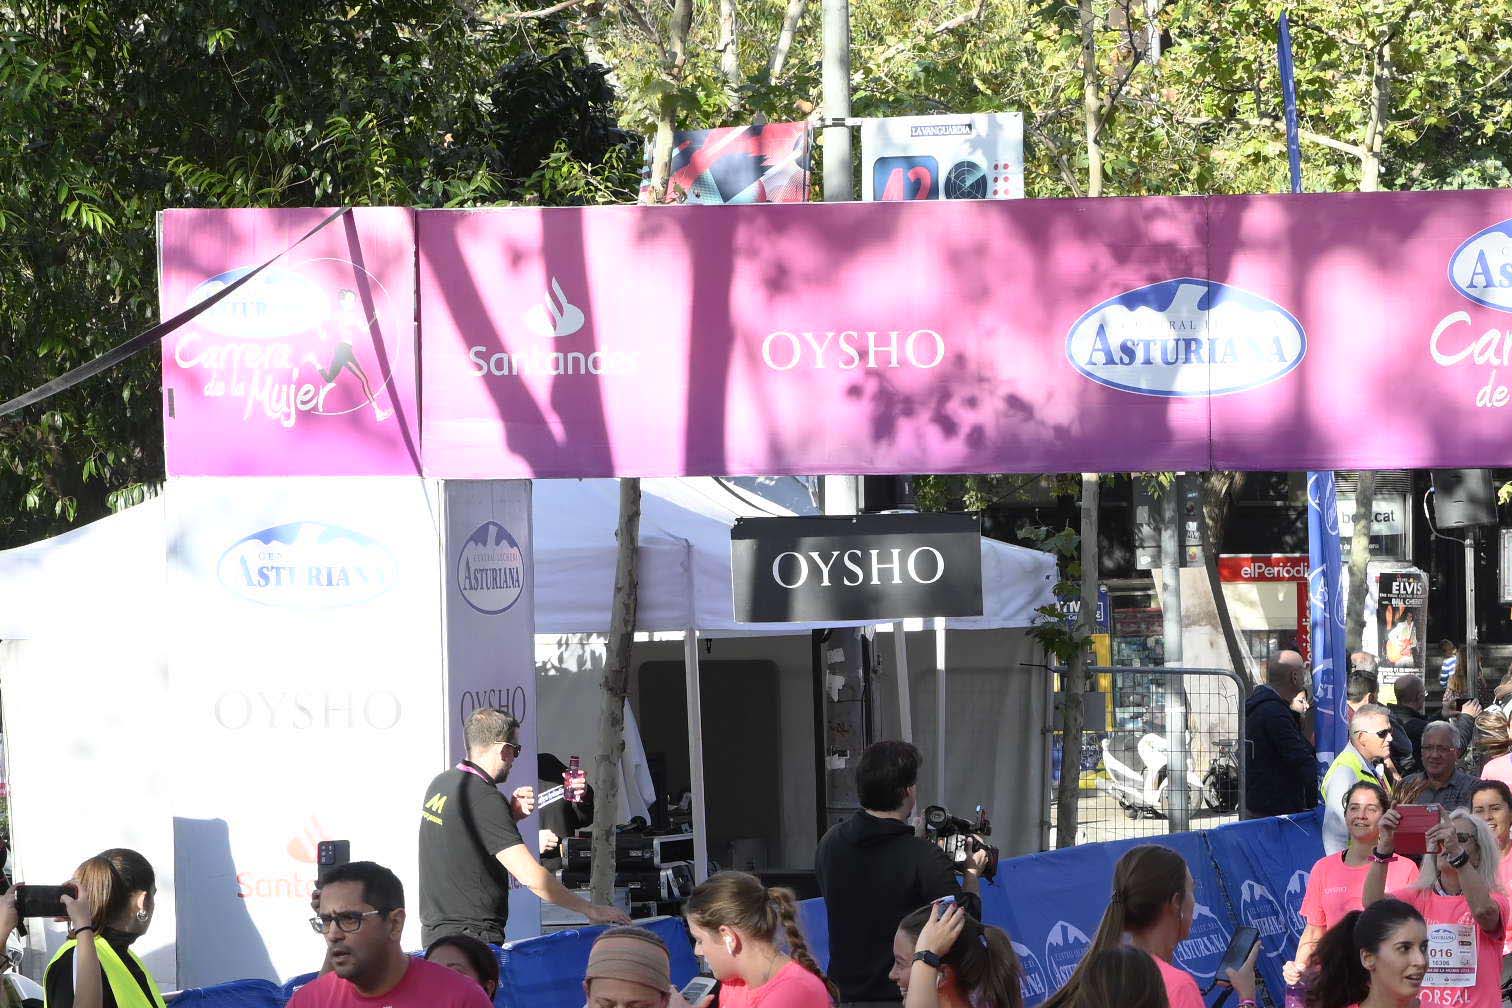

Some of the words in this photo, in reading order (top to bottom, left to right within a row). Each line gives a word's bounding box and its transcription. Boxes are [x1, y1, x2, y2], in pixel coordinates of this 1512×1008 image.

[174, 334, 293, 370] Carrera
[468, 346, 641, 377] Santander
[761, 328, 946, 371] OYSHO
[1085, 323, 1290, 367] ASTURIANA
[244, 367, 337, 428] Mujer
[1476, 370, 1510, 409] de
[463, 559, 521, 592] ASTURIANA
[772, 546, 946, 590] OYSHO
[1241, 562, 1310, 578] elPeriódi
[1392, 580, 1423, 595] ELVIS
[214, 689, 402, 731] OYSHO
[1429, 948, 1453, 959] 016
